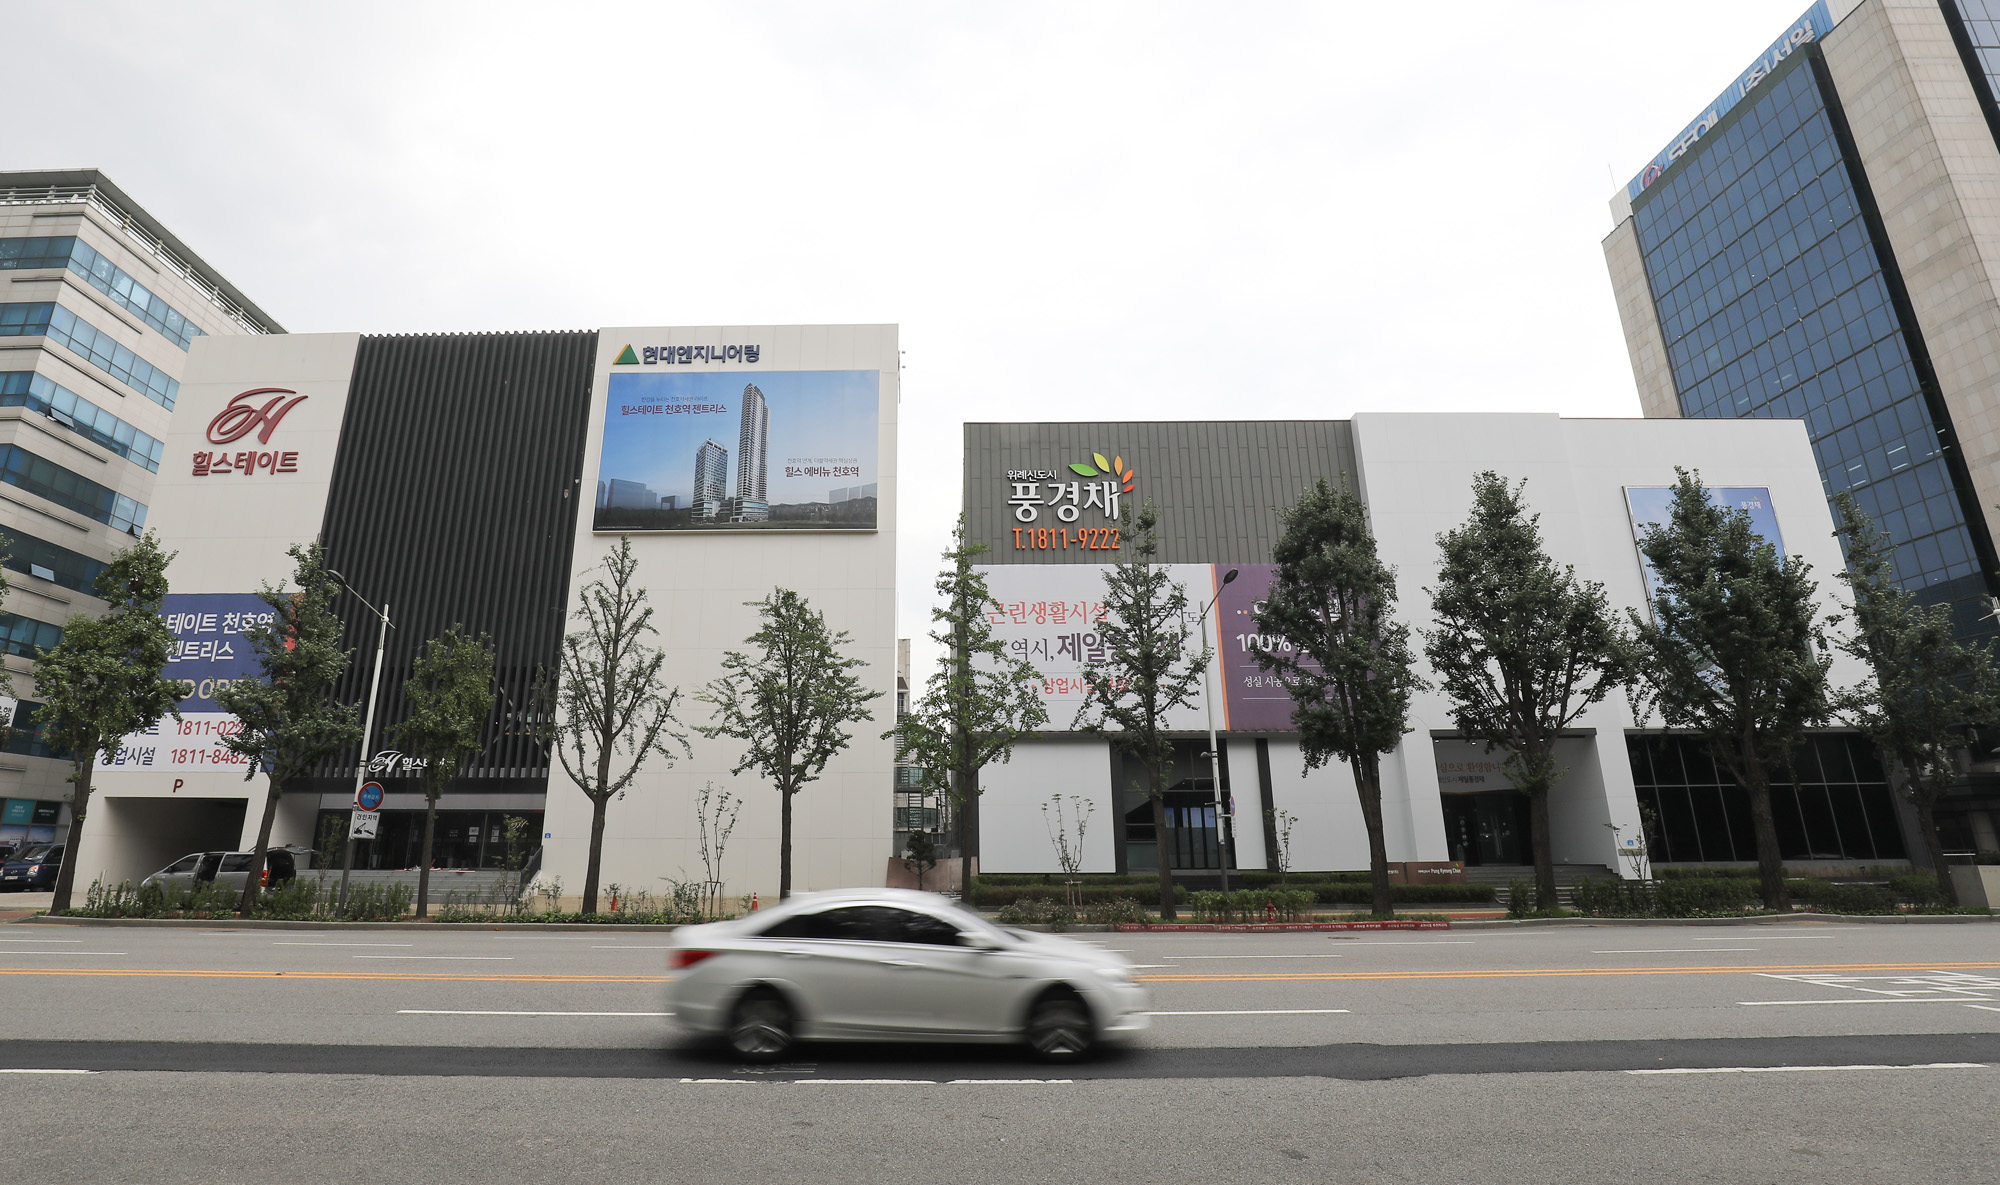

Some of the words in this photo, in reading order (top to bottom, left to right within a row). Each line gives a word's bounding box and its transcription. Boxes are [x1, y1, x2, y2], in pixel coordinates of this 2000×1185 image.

[642, 344, 760, 365] 현대엔지니어링
[621, 405, 663, 415] 힐스테이트
[665, 404, 690, 414] 천호역
[692, 404, 727, 414] 젠트리스
[192, 451, 299, 476] 힐스테이트
[785, 466, 803, 477] 힐스
[804, 466, 831, 477] 에비뉴
[833, 466, 859, 477] 천호역
[1007, 470, 1057, 481] 위례신도시
[1007, 481, 1120, 522] 풍경채
[1012, 528, 1121, 549] T.1811-9222
[986, 600, 1108, 625] 근린생활시설
[171, 749, 249, 764] 1811-8482
[172, 779, 184, 793] P
